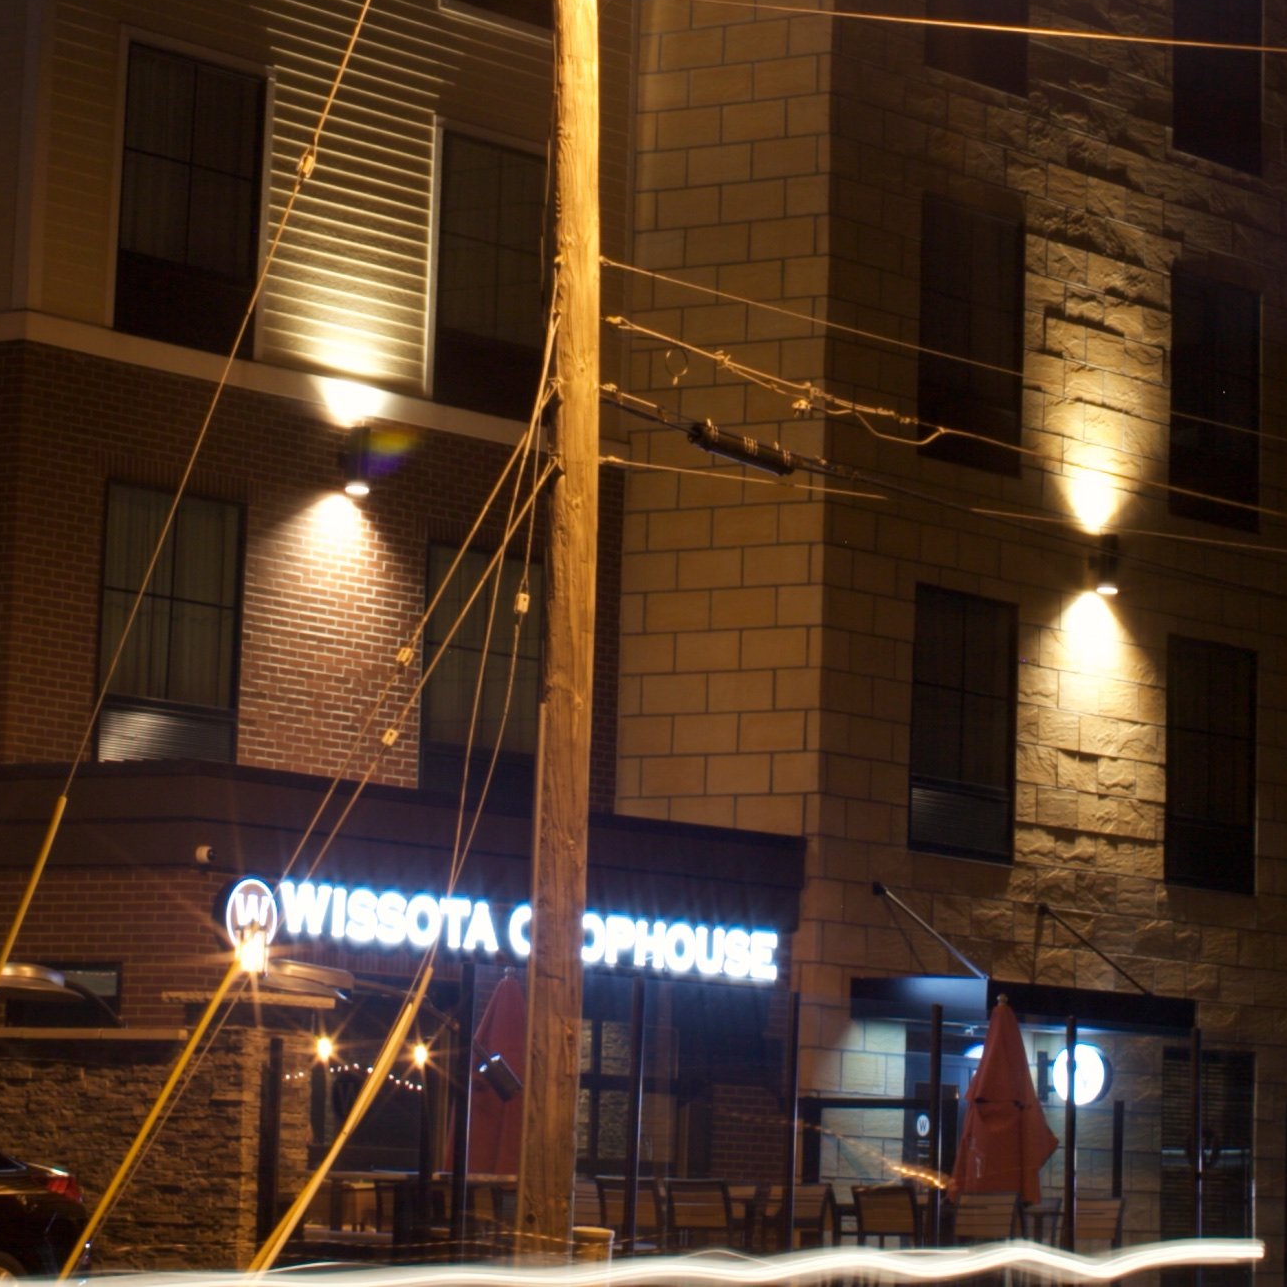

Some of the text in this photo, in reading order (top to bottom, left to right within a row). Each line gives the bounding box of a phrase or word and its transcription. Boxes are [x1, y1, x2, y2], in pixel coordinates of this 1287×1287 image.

[235, 893, 272, 927] W
[279, 881, 778, 981] WISSOTA COPHOUSE
